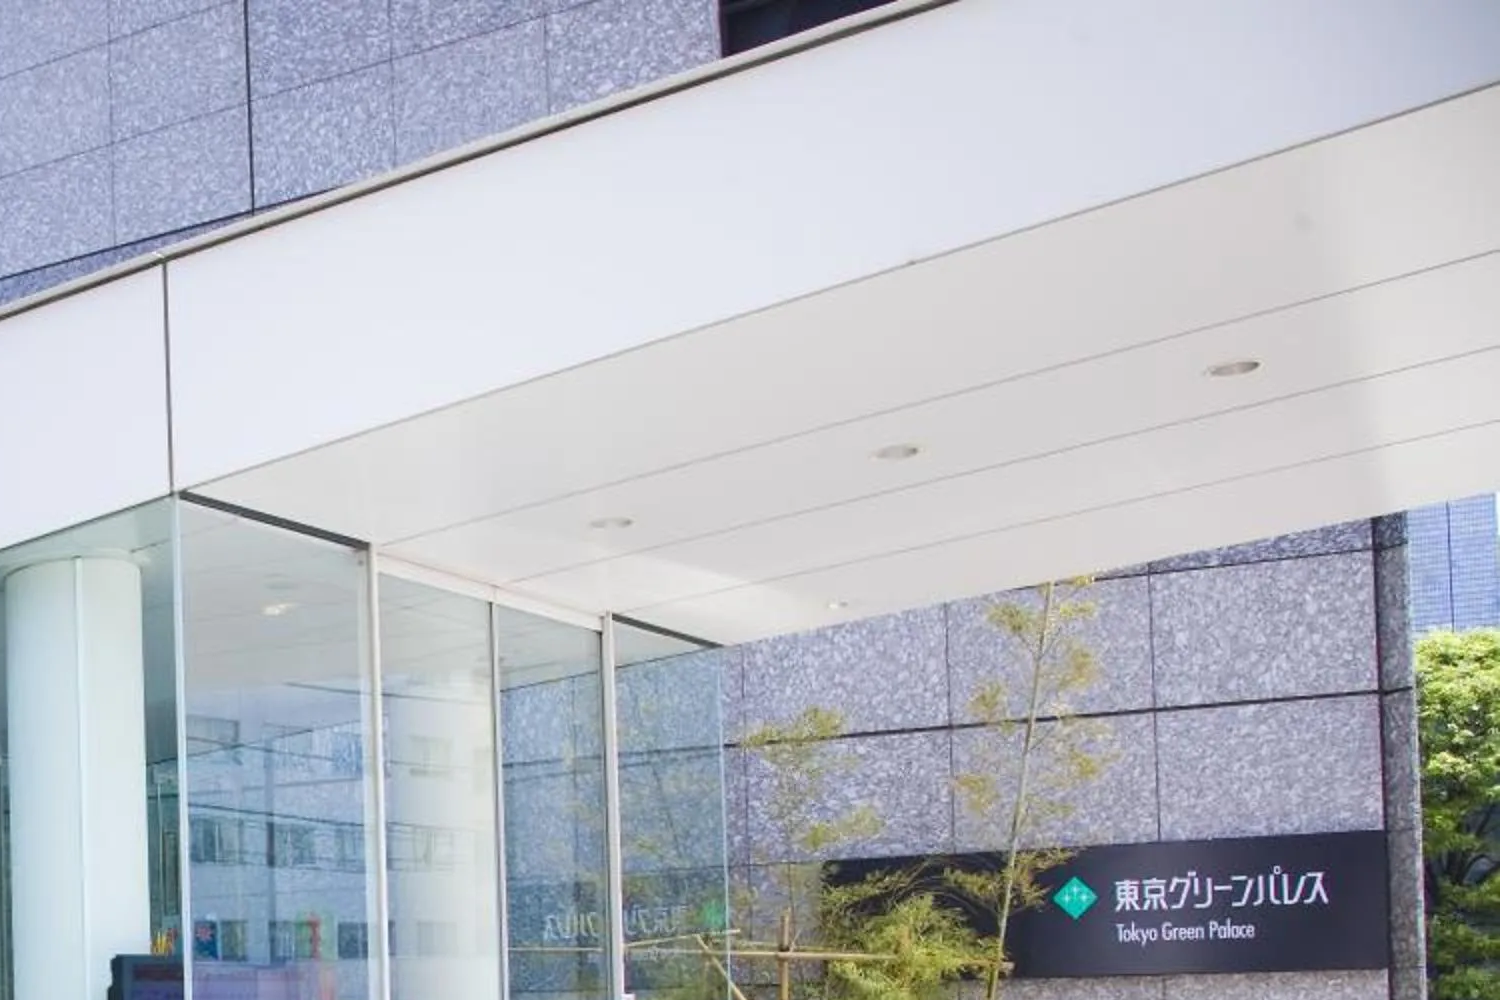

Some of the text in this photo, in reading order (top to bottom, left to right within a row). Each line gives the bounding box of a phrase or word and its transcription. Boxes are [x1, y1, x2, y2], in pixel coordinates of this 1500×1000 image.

[1114, 864, 1330, 912] 東京グリーンパレス
[1116, 917, 1256, 947] Tokyo Green Palace
